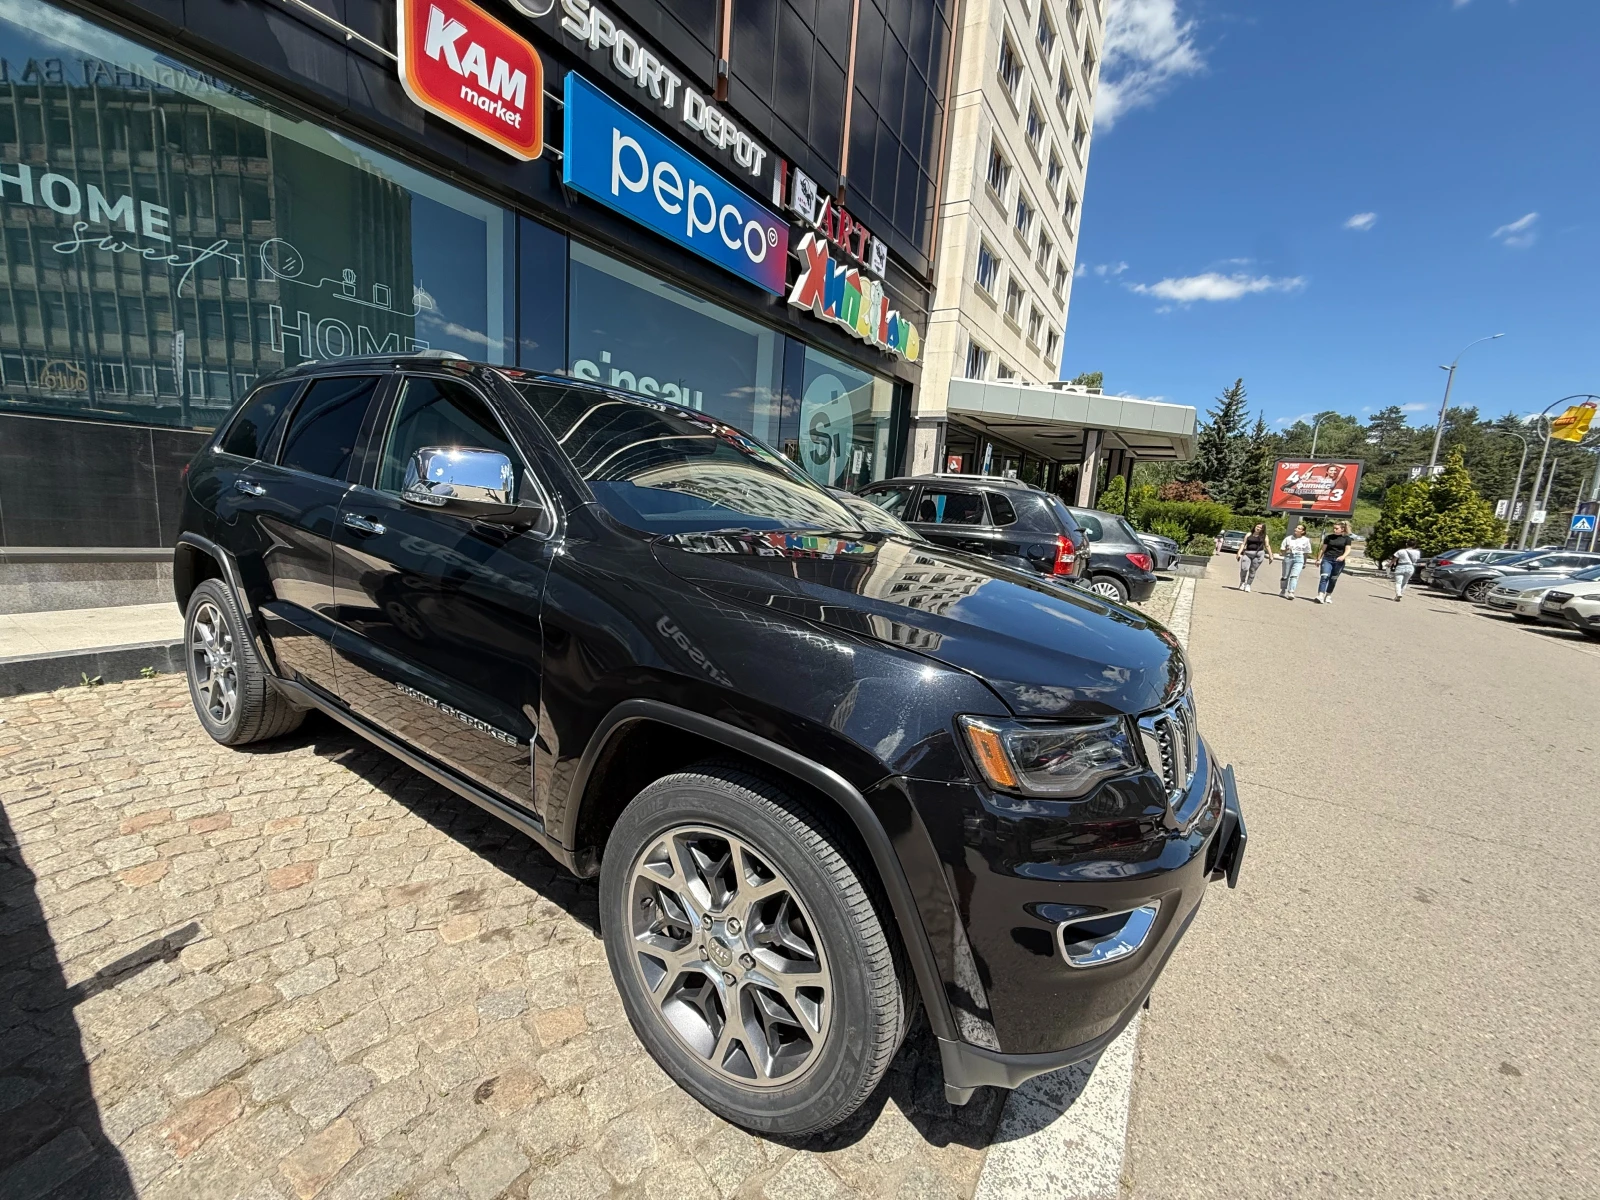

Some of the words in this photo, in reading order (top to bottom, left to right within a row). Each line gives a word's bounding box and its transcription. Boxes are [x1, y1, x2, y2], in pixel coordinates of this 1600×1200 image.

[424, 3, 527, 110] KAM
[561, 0, 681, 109] SPORT
[683, 87, 767, 177] DEPOT
[460, 85, 521, 129] market
[0, 163, 171, 243] HOME
[611, 127, 767, 264] pepco
[816, 195, 871, 263] ART
[1329, 489, 1344, 501] 3
[440, 702, 518, 747] CHEROKEE
